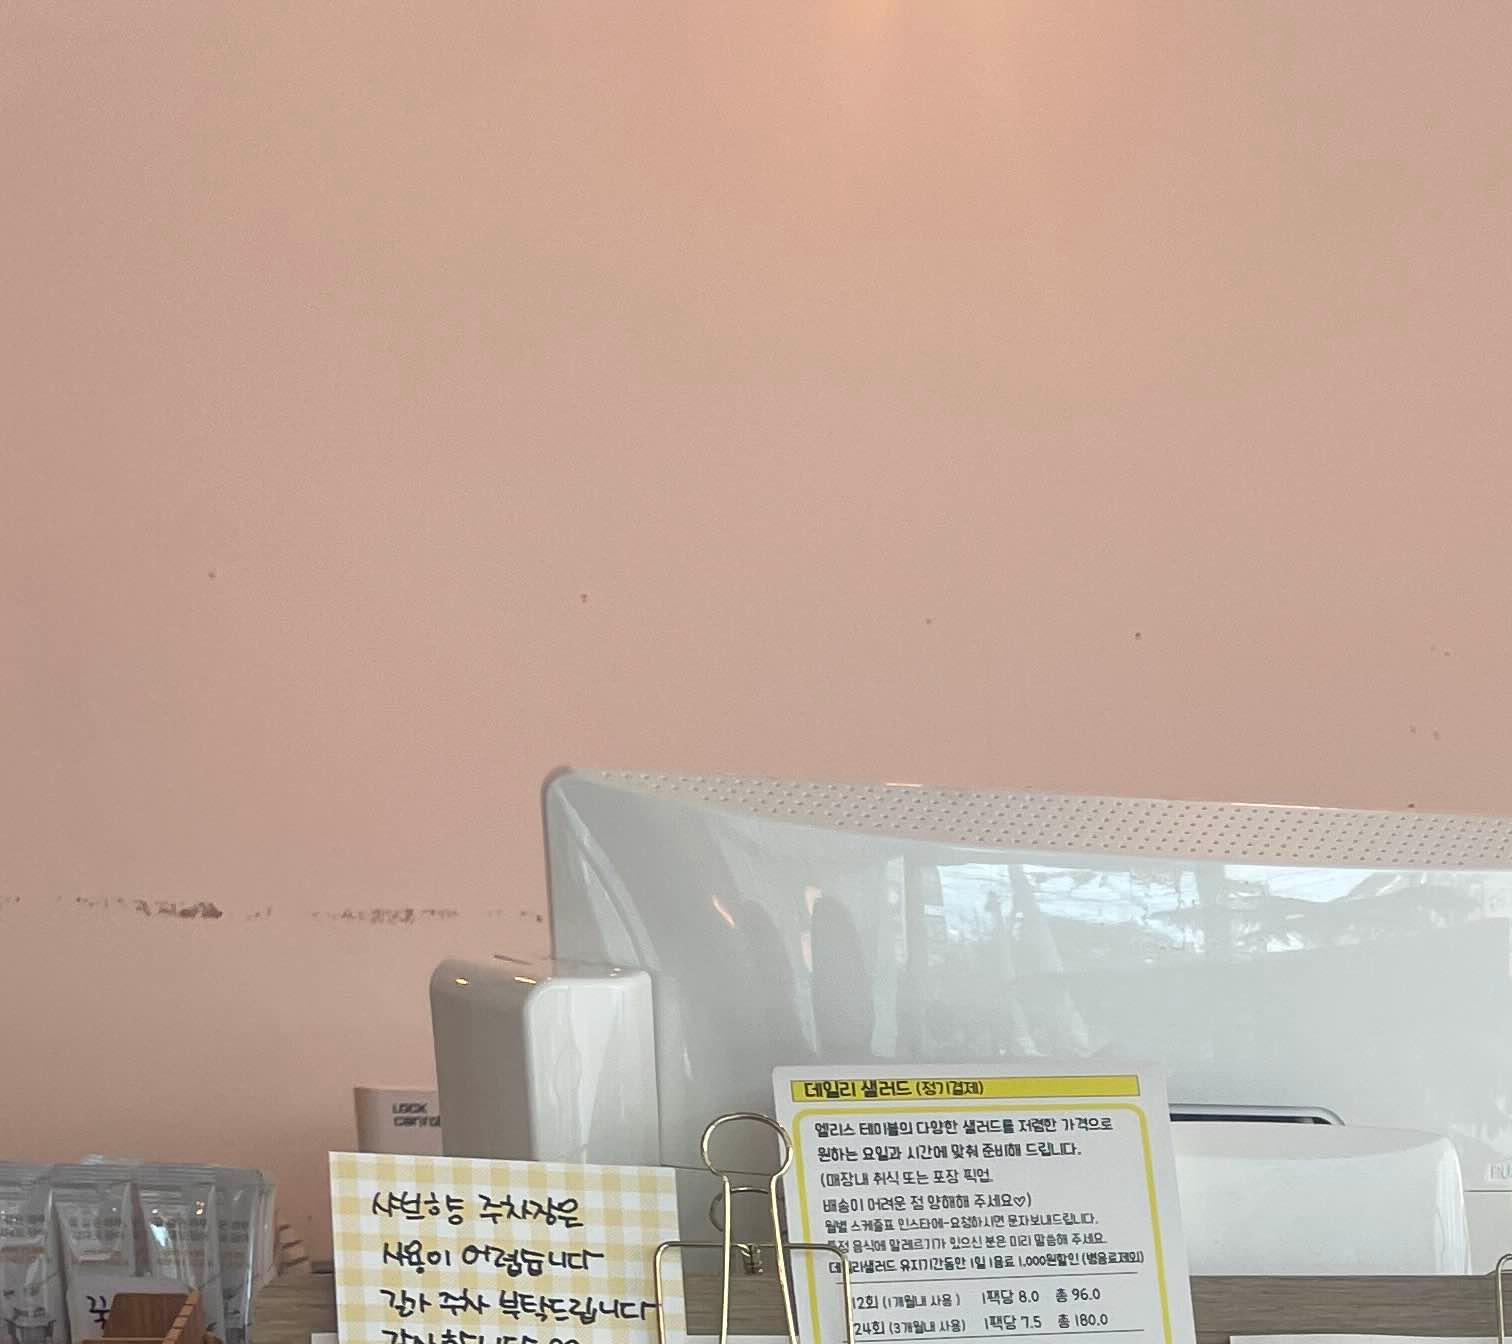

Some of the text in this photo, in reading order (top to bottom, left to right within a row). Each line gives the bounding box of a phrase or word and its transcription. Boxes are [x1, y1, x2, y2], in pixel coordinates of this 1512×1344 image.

[804, 1081, 984, 1097] 데일리 샐러드 (정기결제)
[815, 1117, 1113, 1138] 엘리스 테이블의 다양한 샐러드를 저렴한 가격으로
[818, 1142, 1081, 1162] 원하는 요일과 시간에 맞춰 준비해 드립니다.
[383, 1240, 604, 1276] 사용이 어렵습니다
[500, 1290, 661, 1324] 부탁드립니다
[883, 1293, 927, 1309] (1개월내
[931, 1292, 952, 1308] 사용
[982, 1290, 1013, 1306] 1팩당
[1019, 1288, 1039, 1303] 8.0
[1056, 1288, 1068, 1303] 총
[1072, 1287, 1101, 1302] 96.0
